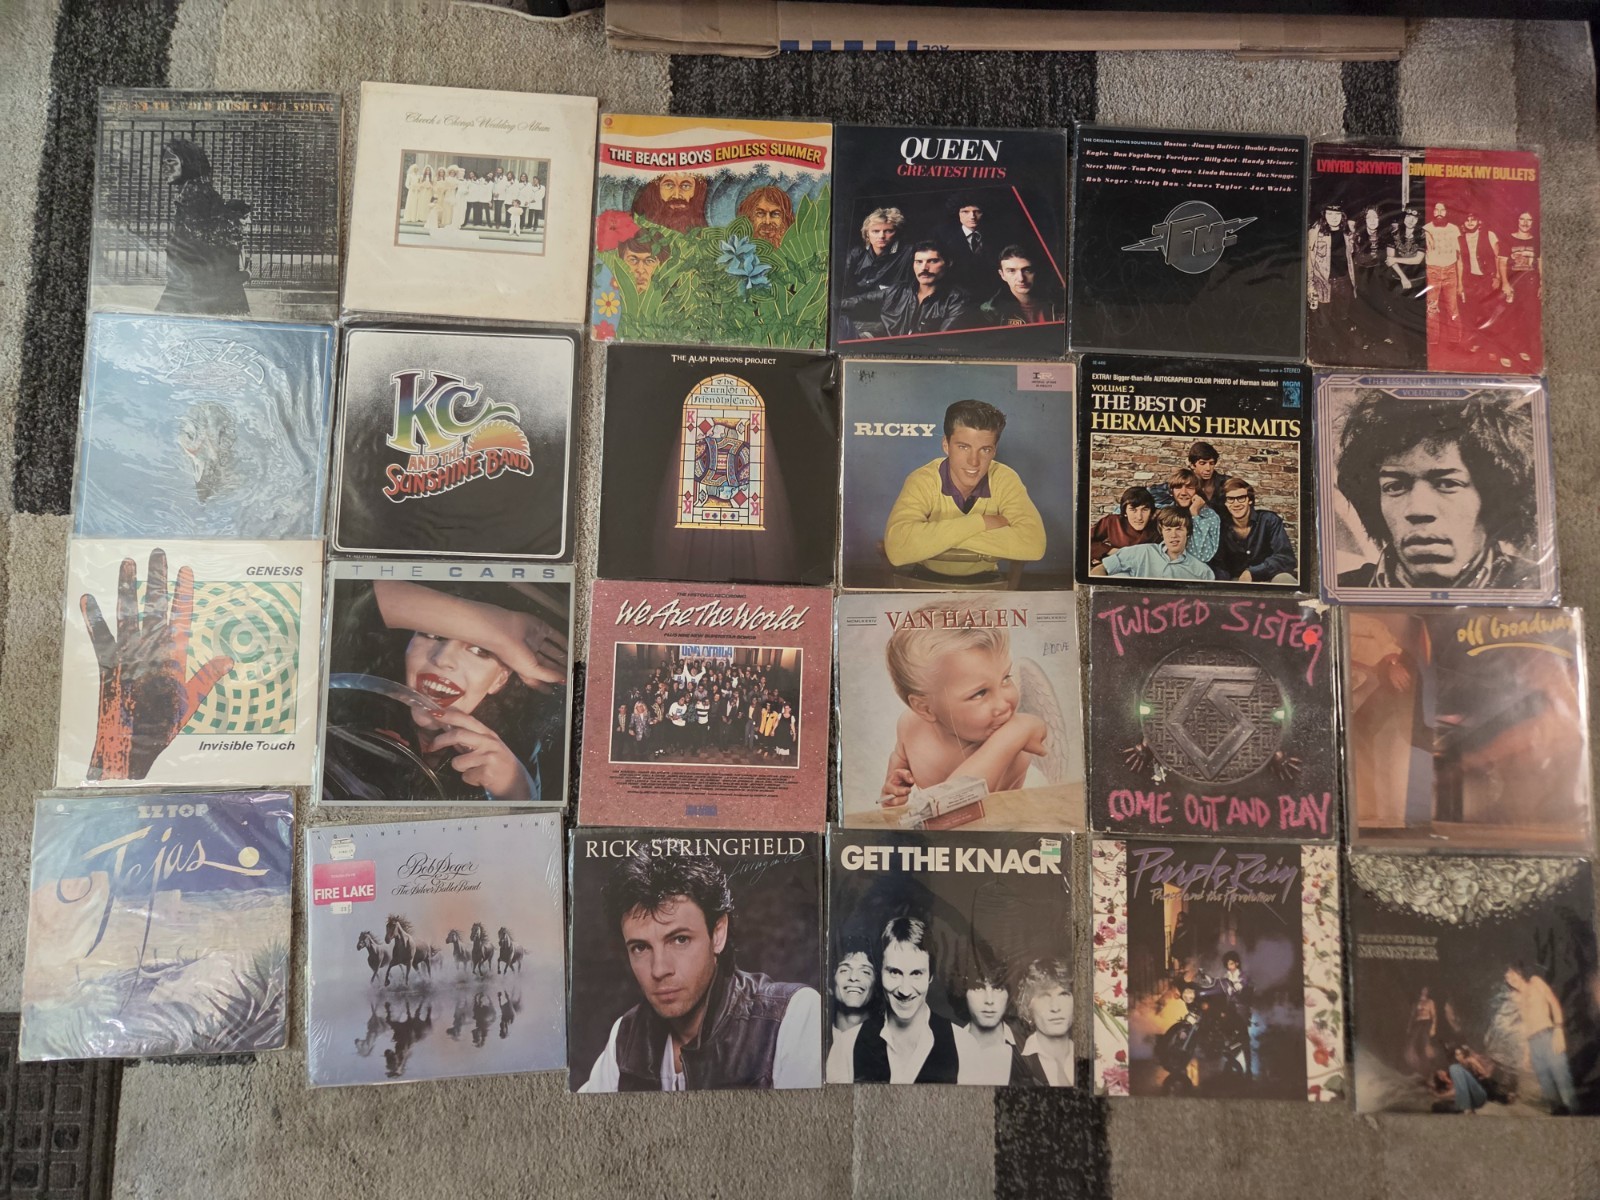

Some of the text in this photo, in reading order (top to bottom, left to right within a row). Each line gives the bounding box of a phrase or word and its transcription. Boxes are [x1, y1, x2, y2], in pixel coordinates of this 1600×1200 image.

[217, 100, 250, 111] RUSH
[293, 101, 334, 112] YOUNG
[475, 116, 516, 134] Wedding
[517, 120, 551, 132] Album
[609, 142, 822, 166] THE BEACH BOYS ENDLESS SUMMER
[900, 136, 1003, 165] QUEEN
[1086, 149, 1109, 157] Eagles
[1128, 152, 1162, 160] Fogelberg
[897, 164, 1007, 179] GREATEST HITS
[1105, 163, 1127, 171] Miller
[1147, 166, 1167, 174] Petty
[1316, 159, 1402, 176] LYNYRD SKYNYRD
[1407, 163, 1536, 182] GIMME BACK MY BULLETS
[671, 354, 777, 366] THE ALAN PARSONS PROJECT
[1113, 374, 1152, 382] Bigger-than-life
[1153, 375, 1193, 383] AUTOGRAPHED
[1213, 377, 1231, 385] PHOTO
[703, 386, 725, 394] Turn
[1091, 384, 1135, 393] VOLUME 2
[1403, 389, 1460, 397] VOLUME TWO
[732, 395, 755, 405] Card
[1091, 393, 1207, 413] THE BEST OF
[386, 369, 521, 454] KC
[686, 410, 696, 423] K
[751, 413, 760, 426] K
[854, 422, 936, 437] RICKY
[1090, 412, 1301, 438] HERMAN'S HERMITS
[407, 443, 464, 472] AND THE
[383, 448, 534, 503] SUNSHINE BAND
[246, 566, 304, 576] GENESIS
[351, 565, 555, 579] THE CARS
[615, 599, 810, 631] We Are The World
[884, 608, 1029, 631] VAN HALEN
[1456, 615, 1490, 646] off
[199, 740, 296, 752] Invisible Touch
[137, 803, 209, 819] ZZ TOP
[1108, 788, 1173, 824] COME
[1226, 797, 1271, 829] AND
[1279, 792, 1331, 834] PLAY
[585, 837, 806, 858] RICK SPRINGFIELD
[397, 852, 480, 881] Bob Seger
[840, 845, 894, 871] GET
[897, 846, 950, 872] THE
[1130, 846, 1299, 904] Purple Rain
[314, 884, 374, 901] FIRE LAKE
[391, 879, 482, 896] The Silver Bullet Band
[1206, 890, 1221, 903] the
